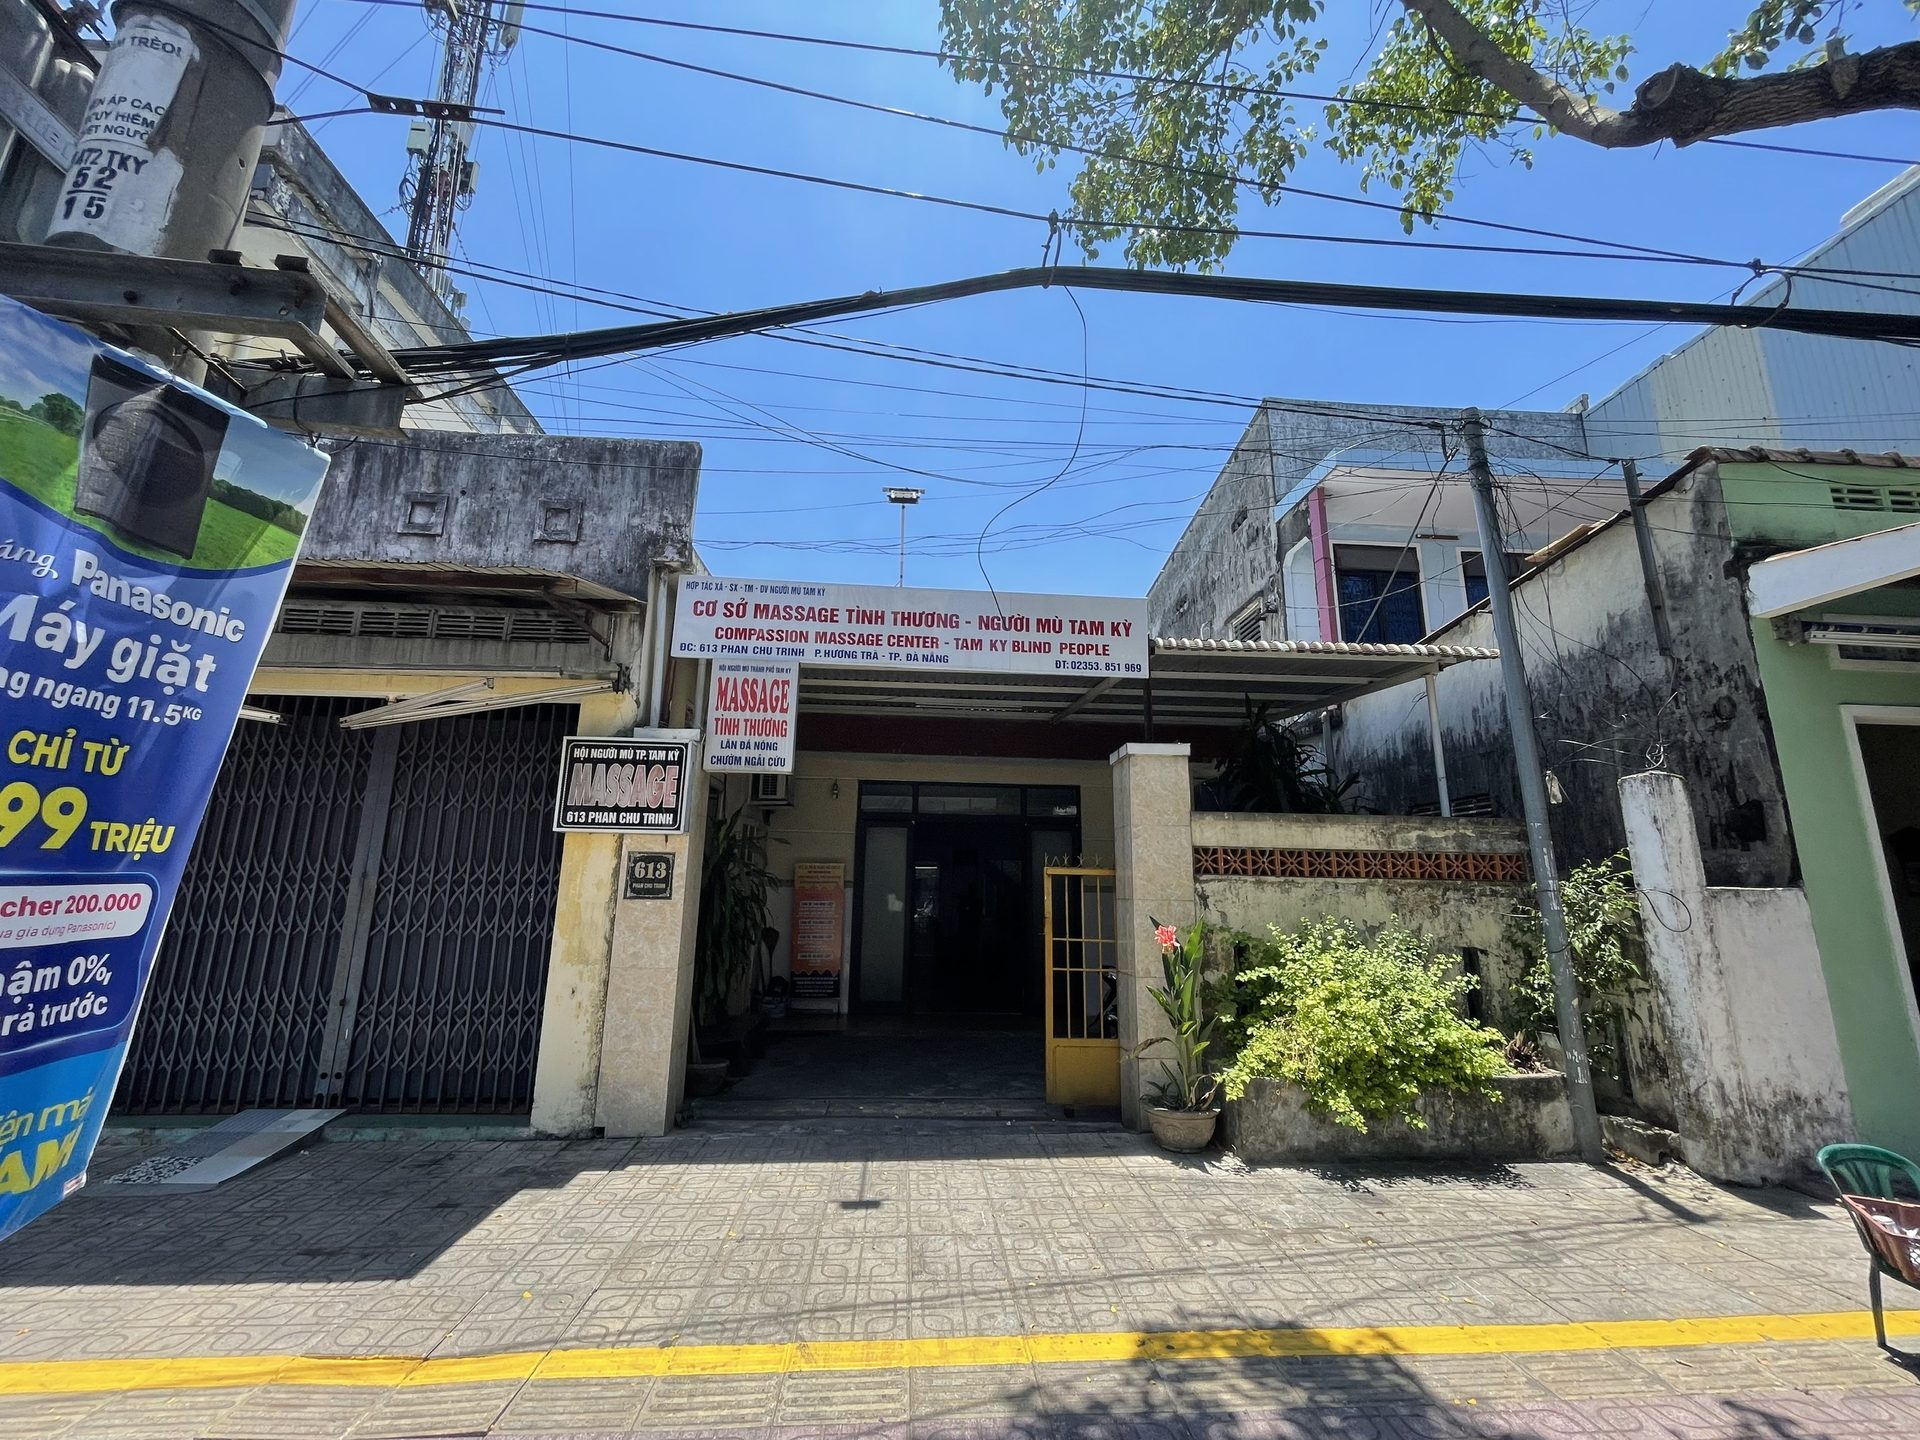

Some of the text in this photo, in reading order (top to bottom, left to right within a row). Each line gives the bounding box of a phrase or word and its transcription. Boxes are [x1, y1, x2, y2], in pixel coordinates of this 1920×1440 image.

[72, 548, 245, 642] Panasonic
[701, 580, 713, 591] TÁC
[729, 583, 738, 592] SX
[744, 584, 754, 593] TM
[760, 584, 769, 594] DV
[802, 586, 816, 596] TAM
[693, 599, 719, 617] CƠ
[722, 597, 748, 619] SỞ
[753, 603, 840, 624] MASSAGE
[846, 605, 885, 626] TÌNH
[890, 610, 960, 629] THƯƠNG
[977, 613, 1030, 633] NGƯỜI
[1036, 615, 1063, 634] MÙ
[1069, 619, 1105, 636] TAM
[1110, 618, 1133, 638] KỲ
[679, 642, 697, 652] ĐC:
[699, 643, 718, 653] 613
[720, 644, 748, 655] PHAN
[752, 646, 773, 656] CHU
[776, 647, 805, 657] TRINH
[861, 649, 879, 660] TRÀ
[889, 652, 902, 661] TP.
[906, 651, 919, 662] ĐÀ
[714, 626, 809, 644] COMPASSION
[814, 631, 883, 647] MASSAGE
[887, 634, 940, 649] CENTER
[954, 637, 983, 651] TAM
[990, 639, 1008, 652] KY
[1012, 640, 1052, 654] BLIND
[1060, 642, 1110, 656] PEOPLE
[106, 634, 217, 696] giặt
[1105, 662, 1121, 672] 851
[1124, 663, 1142, 673] 969
[33, 677, 121, 719] ngang
[715, 676, 791, 714] MASSAGE
[714, 714, 788, 738] TÌNH THƯƠNG
[8, 728, 130, 776] CHỈ TỪ
[573, 746, 589, 760] HỘI
[590, 746, 617, 759] NGƯỜI
[620, 747, 634, 760] MÙ
[649, 750, 666, 760] TAM
[667, 749, 680, 761] KỲ
[740, 738, 751, 750] ĐÁ
[754, 739, 778, 751] NÓNG
[768, 755, 786, 767] CỨU
[567, 763, 680, 809] MASSAGE
[566, 811, 674, 825] 613 PHAN CHU TRINH
[90, 818, 176, 860] TRIỆU
[634, 861, 667, 879] 613
[0, 893, 142, 918] cher 200.000
[15, 926, 38, 940] gia
[67, 921, 116, 933] Panasonic)
[0, 991, 108, 1036] rả trước
